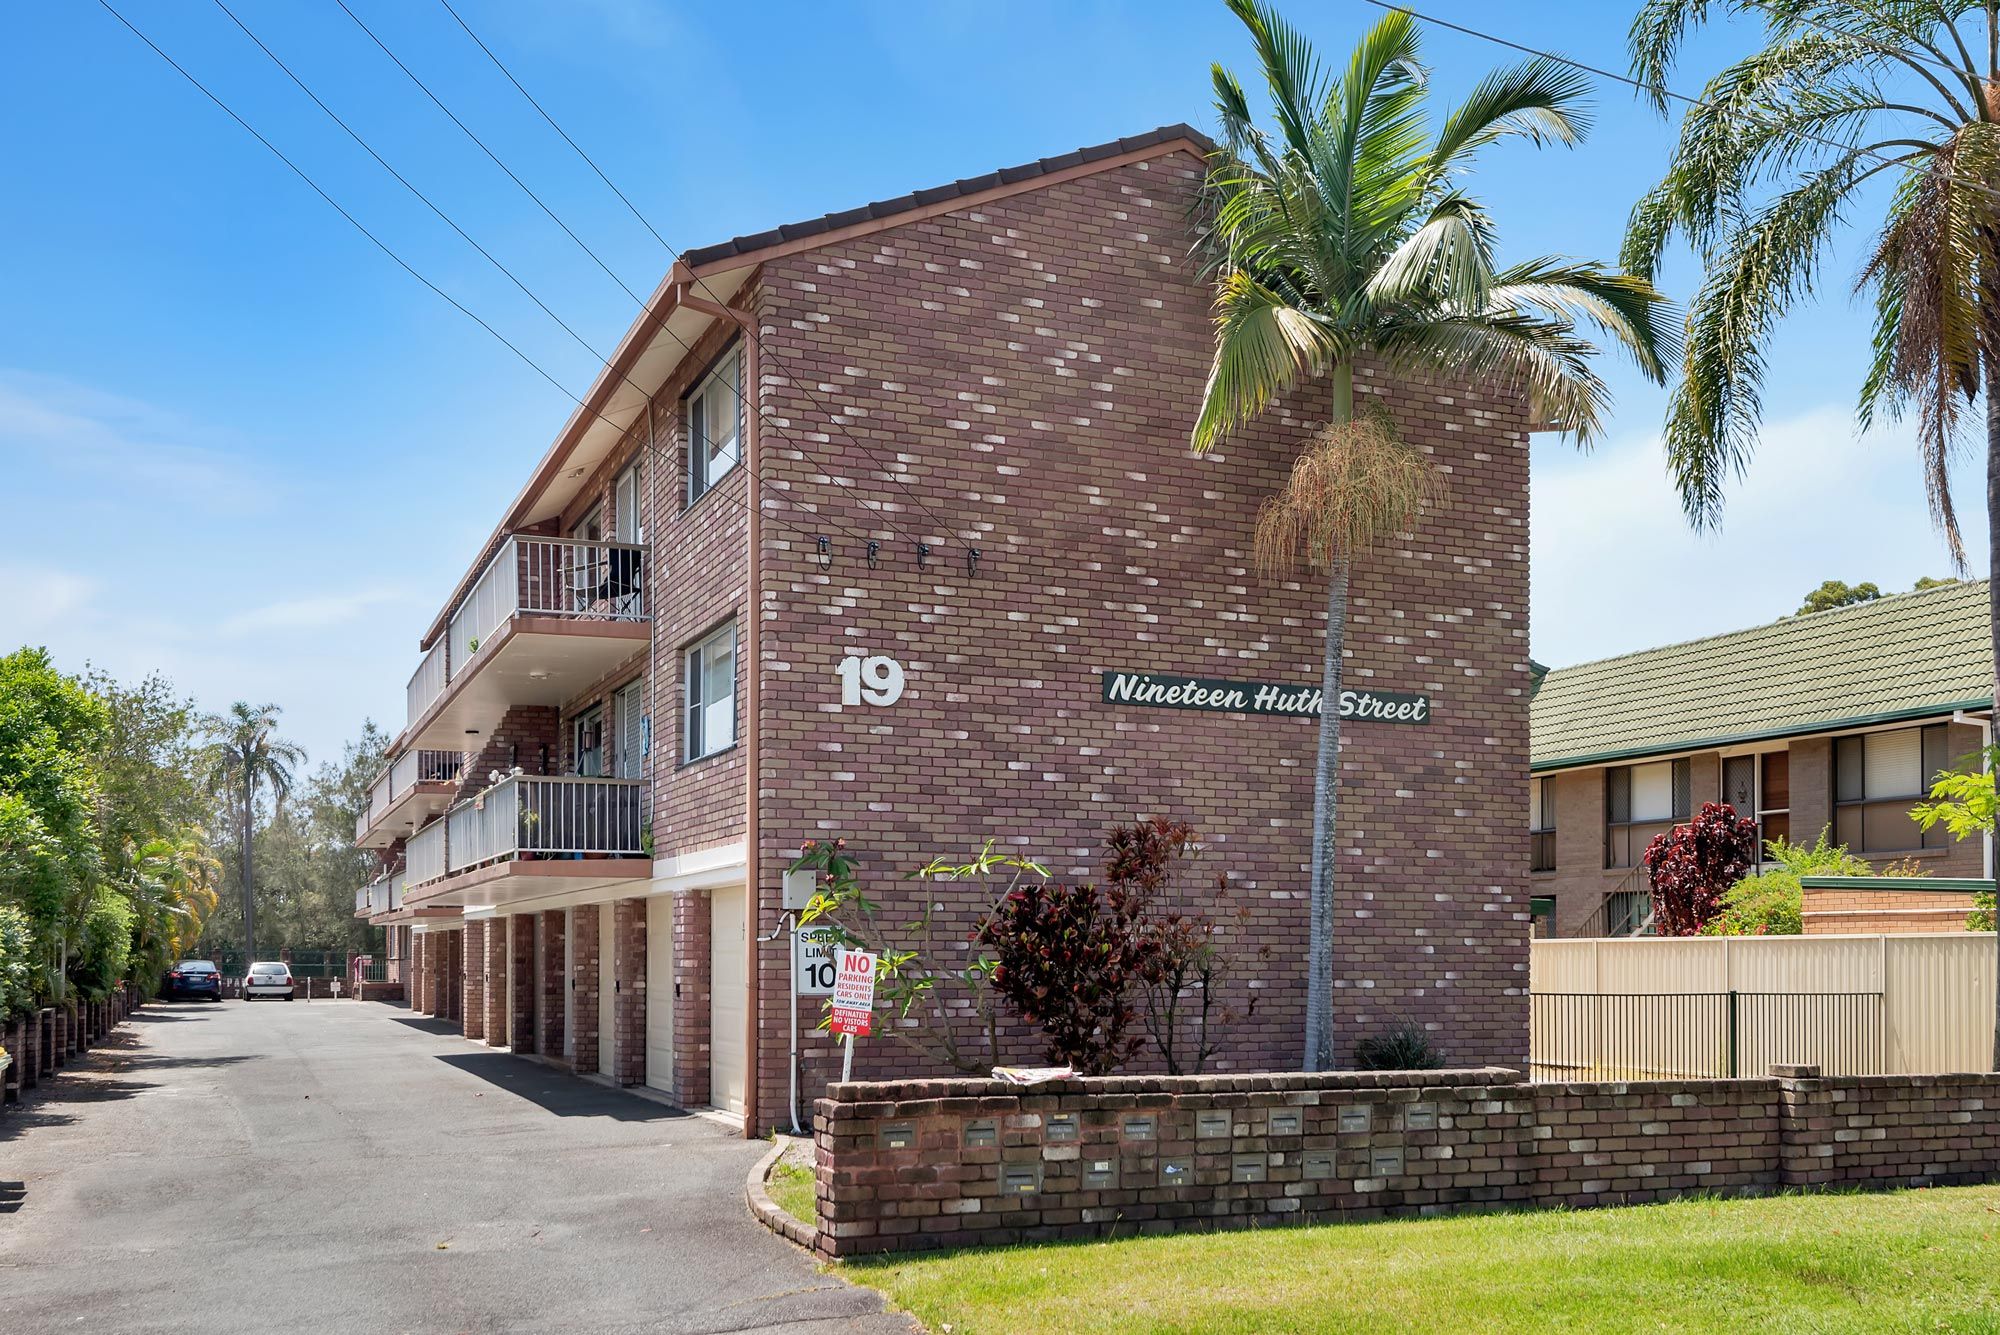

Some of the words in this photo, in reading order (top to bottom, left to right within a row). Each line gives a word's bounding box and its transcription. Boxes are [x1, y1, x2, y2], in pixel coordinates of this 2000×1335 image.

[834, 655, 905, 707] 19
[1108, 673, 1249, 709] Nineteen
[1254, 684, 1324, 714] Huth
[1340, 691, 1427, 721] Street
[801, 932, 840, 943] SPEE
[805, 947, 837, 958] LIMT
[844, 954, 870, 973] NO
[805, 963, 837, 988] 10
[838, 973, 873, 984] PARKING
[837, 983, 872, 992] RESIDENTS
[836, 990, 853, 999] CARS
[853, 992, 871, 1001] ONLY
[834, 1008, 869, 1019] DEFINATELY
[833, 1016, 843, 1024] NO
[844, 1017, 868, 1027] VISTORS
[842, 1024, 857, 1032] CARS
